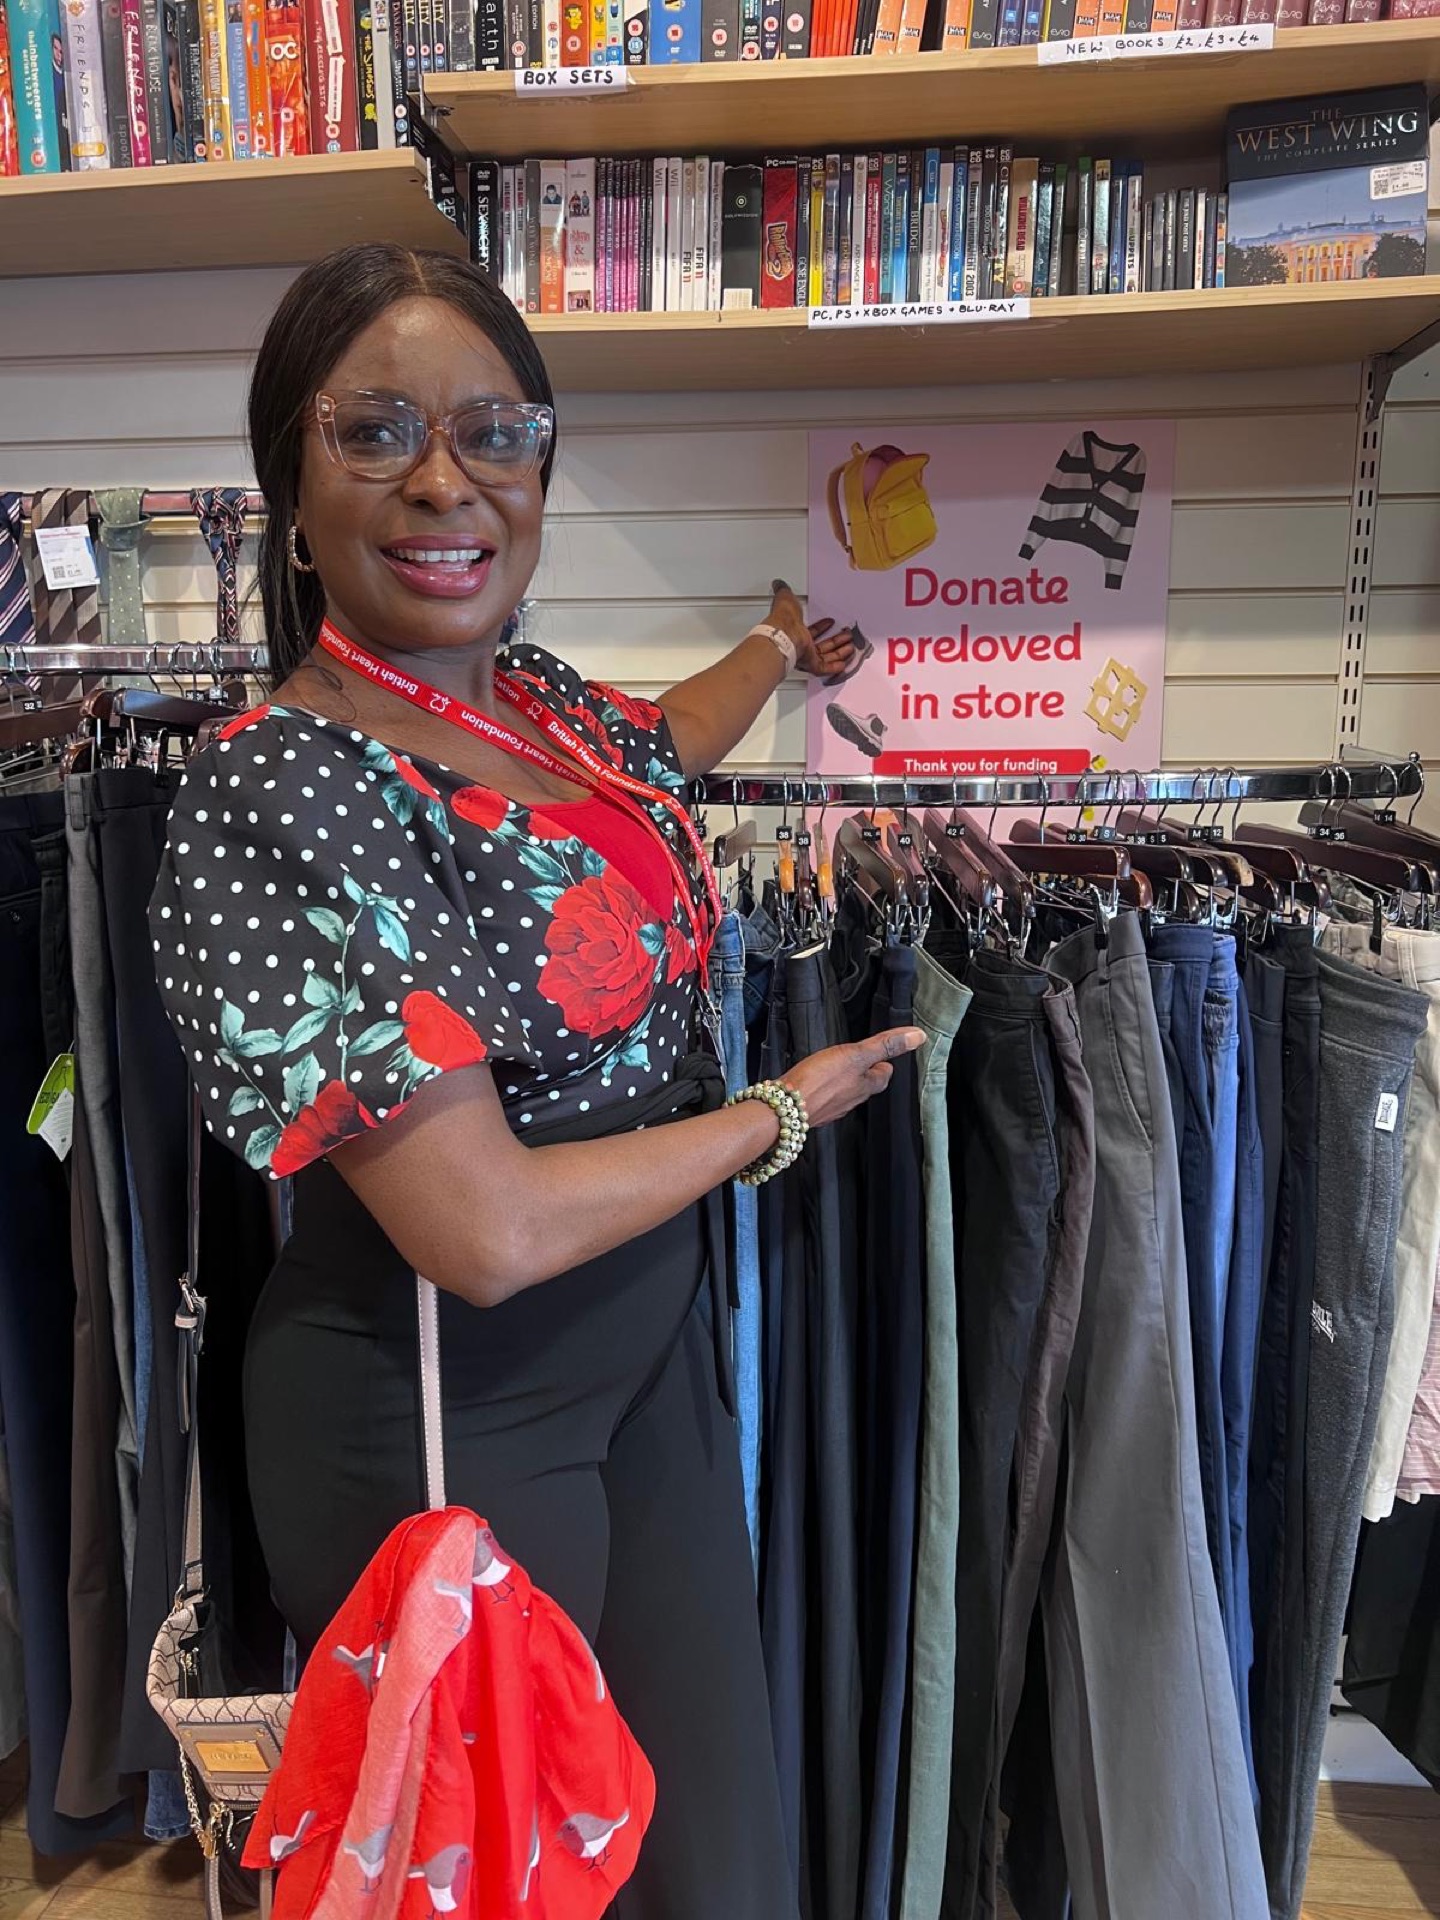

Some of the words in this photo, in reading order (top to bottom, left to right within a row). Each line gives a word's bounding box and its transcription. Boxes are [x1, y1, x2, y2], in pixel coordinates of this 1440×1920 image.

[145, 24, 160, 53] BLEAK
[486, 3, 499, 50] arth
[235, 28, 244, 77] DOWNTON
[1066, 42, 1103, 55] NEW
[1116, 37, 1164, 49] BOOKS
[73, 24, 90, 109] FRIENDS
[125, 11, 144, 114] FRIENDS
[148, 56, 162, 93] HOUSE
[210, 58, 221, 94] ANATOMY
[363, 54, 375, 98] SIMPSONS
[524, 71, 558, 85] BOX
[570, 70, 614, 84] SETS
[238, 82, 246, 114] ABBEY
[1311, 108, 1342, 121] THE
[1236, 123, 1316, 153] WEST
[1329, 111, 1418, 141] WING
[1356, 138, 1397, 150] SERIES
[118, 124, 130, 167] spooks
[654, 168, 663, 187] Wii
[670, 168, 679, 187] Wii
[1018, 196, 1028, 229] WALKING
[909, 210, 918, 252] BRIDGE
[1016, 231, 1026, 251] DEAD
[967, 217, 978, 271] TOURNAMENT
[683, 251, 691, 273] FIFA
[695, 247, 704, 268] FIFA
[768, 259, 781, 276] 2
[797, 256, 807, 277] GCSE
[966, 275, 974, 296] 2003
[836, 309, 851, 319] PS
[863, 307, 896, 317] XBOX
[901, 305, 943, 317] GAMES
[904, 568, 1069, 607] Donate
[887, 622, 1082, 675] preloved
[351, 651, 380, 676] Heart
[379, 668, 419, 695] British
[901, 684, 938, 720] in
[952, 684, 1065, 720] store
[460, 709, 524, 755] Foundation
[522, 744, 556, 770] Heart
[547, 721, 578, 748] British
[575, 744, 602, 773] Heart
[600, 768, 656, 797] Foundation
[904, 759, 947, 773] Thank
[951, 762, 976, 774] you
[980, 758, 999, 771] for
[1003, 758, 1058, 774] funding
[779, 831, 789, 839] 38
[798, 837, 808, 845] 38
[899, 837, 911, 845] 40
[1213, 829, 1222, 837] 12
[1319, 828, 1329, 836] 34
[1334, 832, 1345, 840] 36
